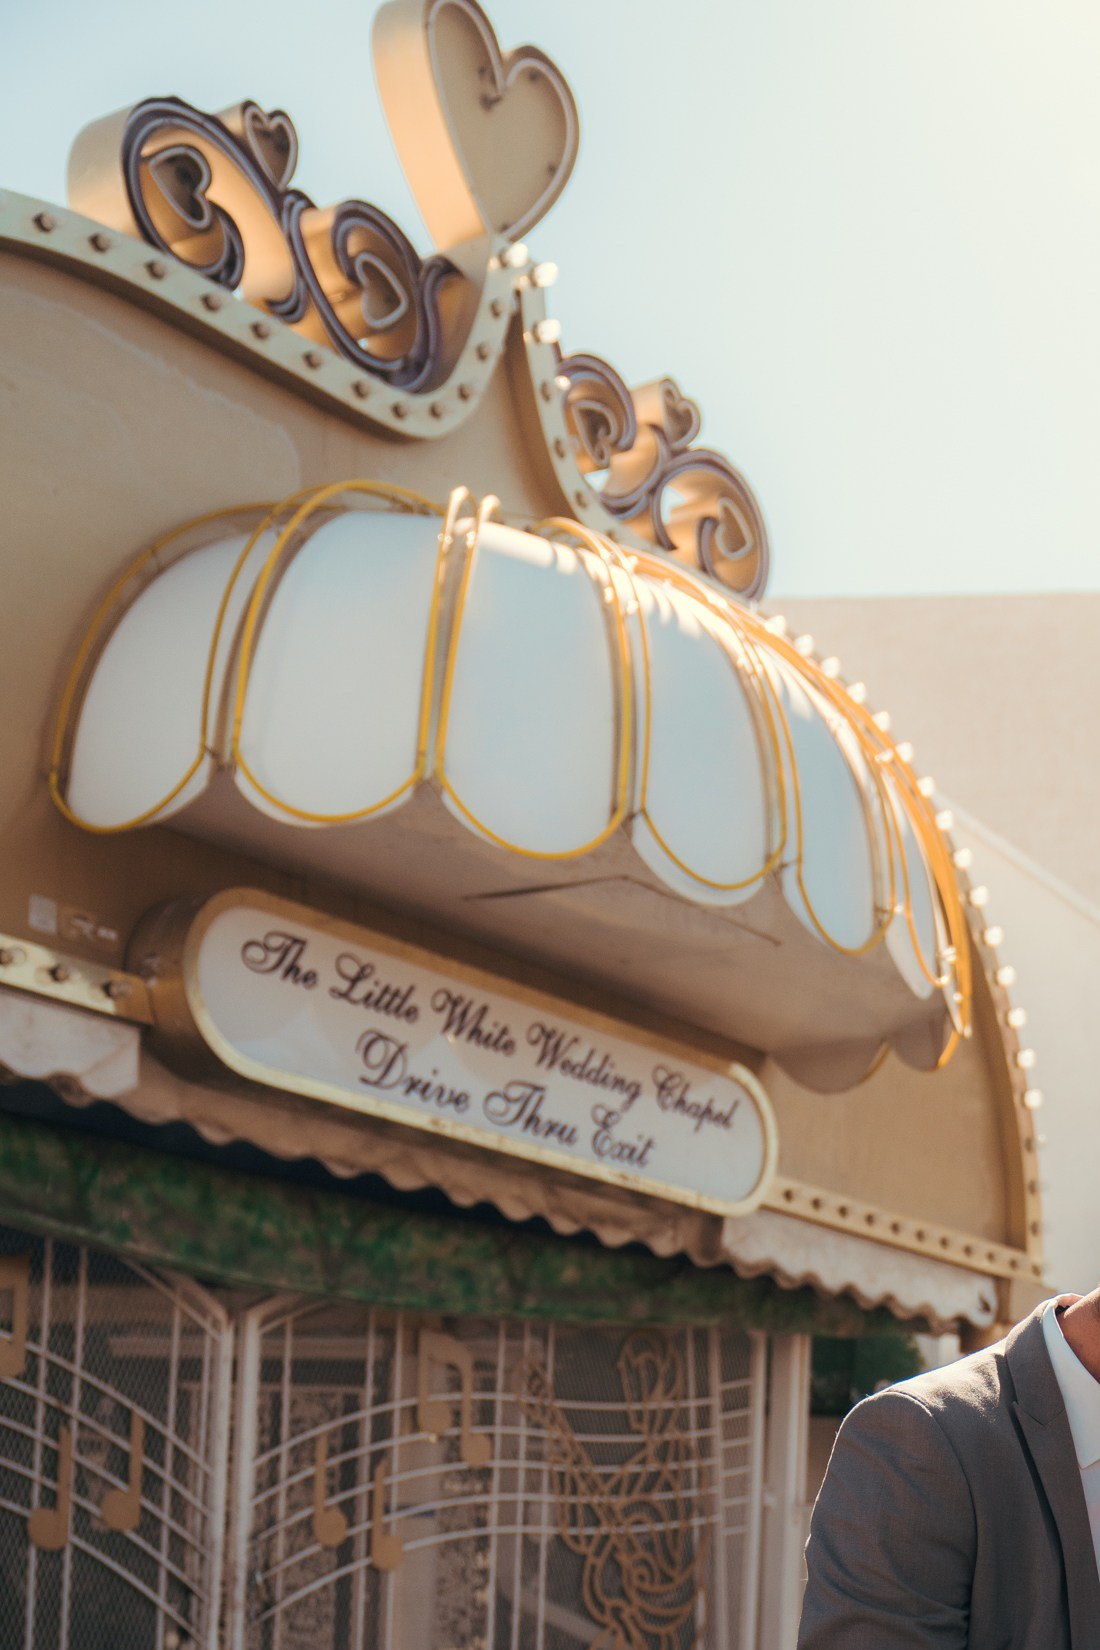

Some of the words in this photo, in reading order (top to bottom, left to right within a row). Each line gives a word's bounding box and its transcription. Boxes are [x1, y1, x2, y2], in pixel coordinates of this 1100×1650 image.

[240, 930, 319, 992] The
[328, 952, 421, 1025] Little
[430, 987, 517, 1057] White
[526, 1019, 643, 1111] Wedding
[651, 1064, 740, 1133] Chapel
[355, 1028, 471, 1114] Drive
[482, 1079, 578, 1148] Thru
[590, 1105, 656, 1169] Exit
